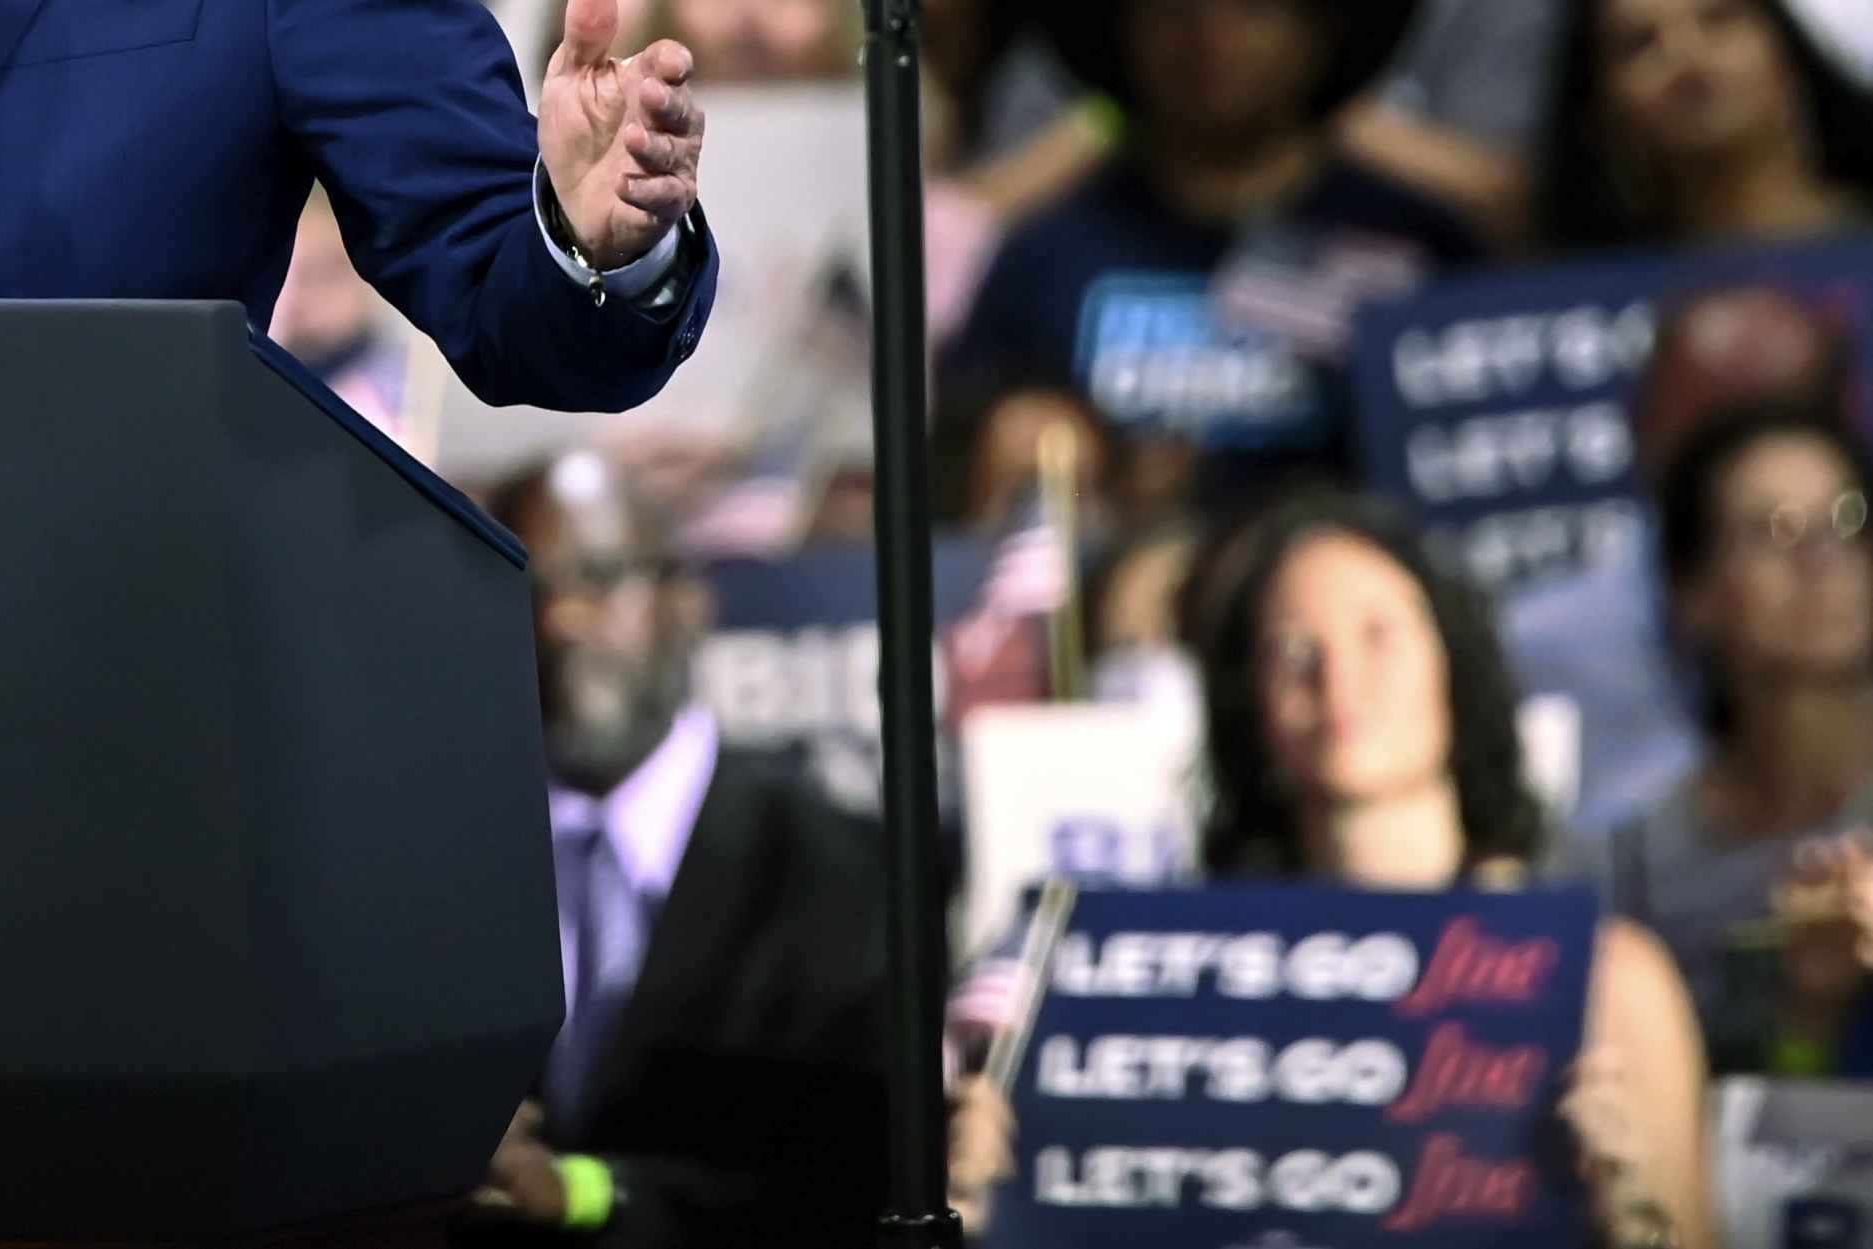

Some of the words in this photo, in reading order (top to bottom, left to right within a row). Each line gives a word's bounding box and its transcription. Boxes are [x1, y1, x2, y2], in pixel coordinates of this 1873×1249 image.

[1052, 930, 1284, 999] LET'S
[1284, 931, 1419, 1002] GO
[1036, 1033, 1269, 1104] LET'S
[1270, 1035, 1407, 1105] GO
[1033, 1144, 1265, 1211] LET'S
[1264, 1147, 1403, 1215] GO
